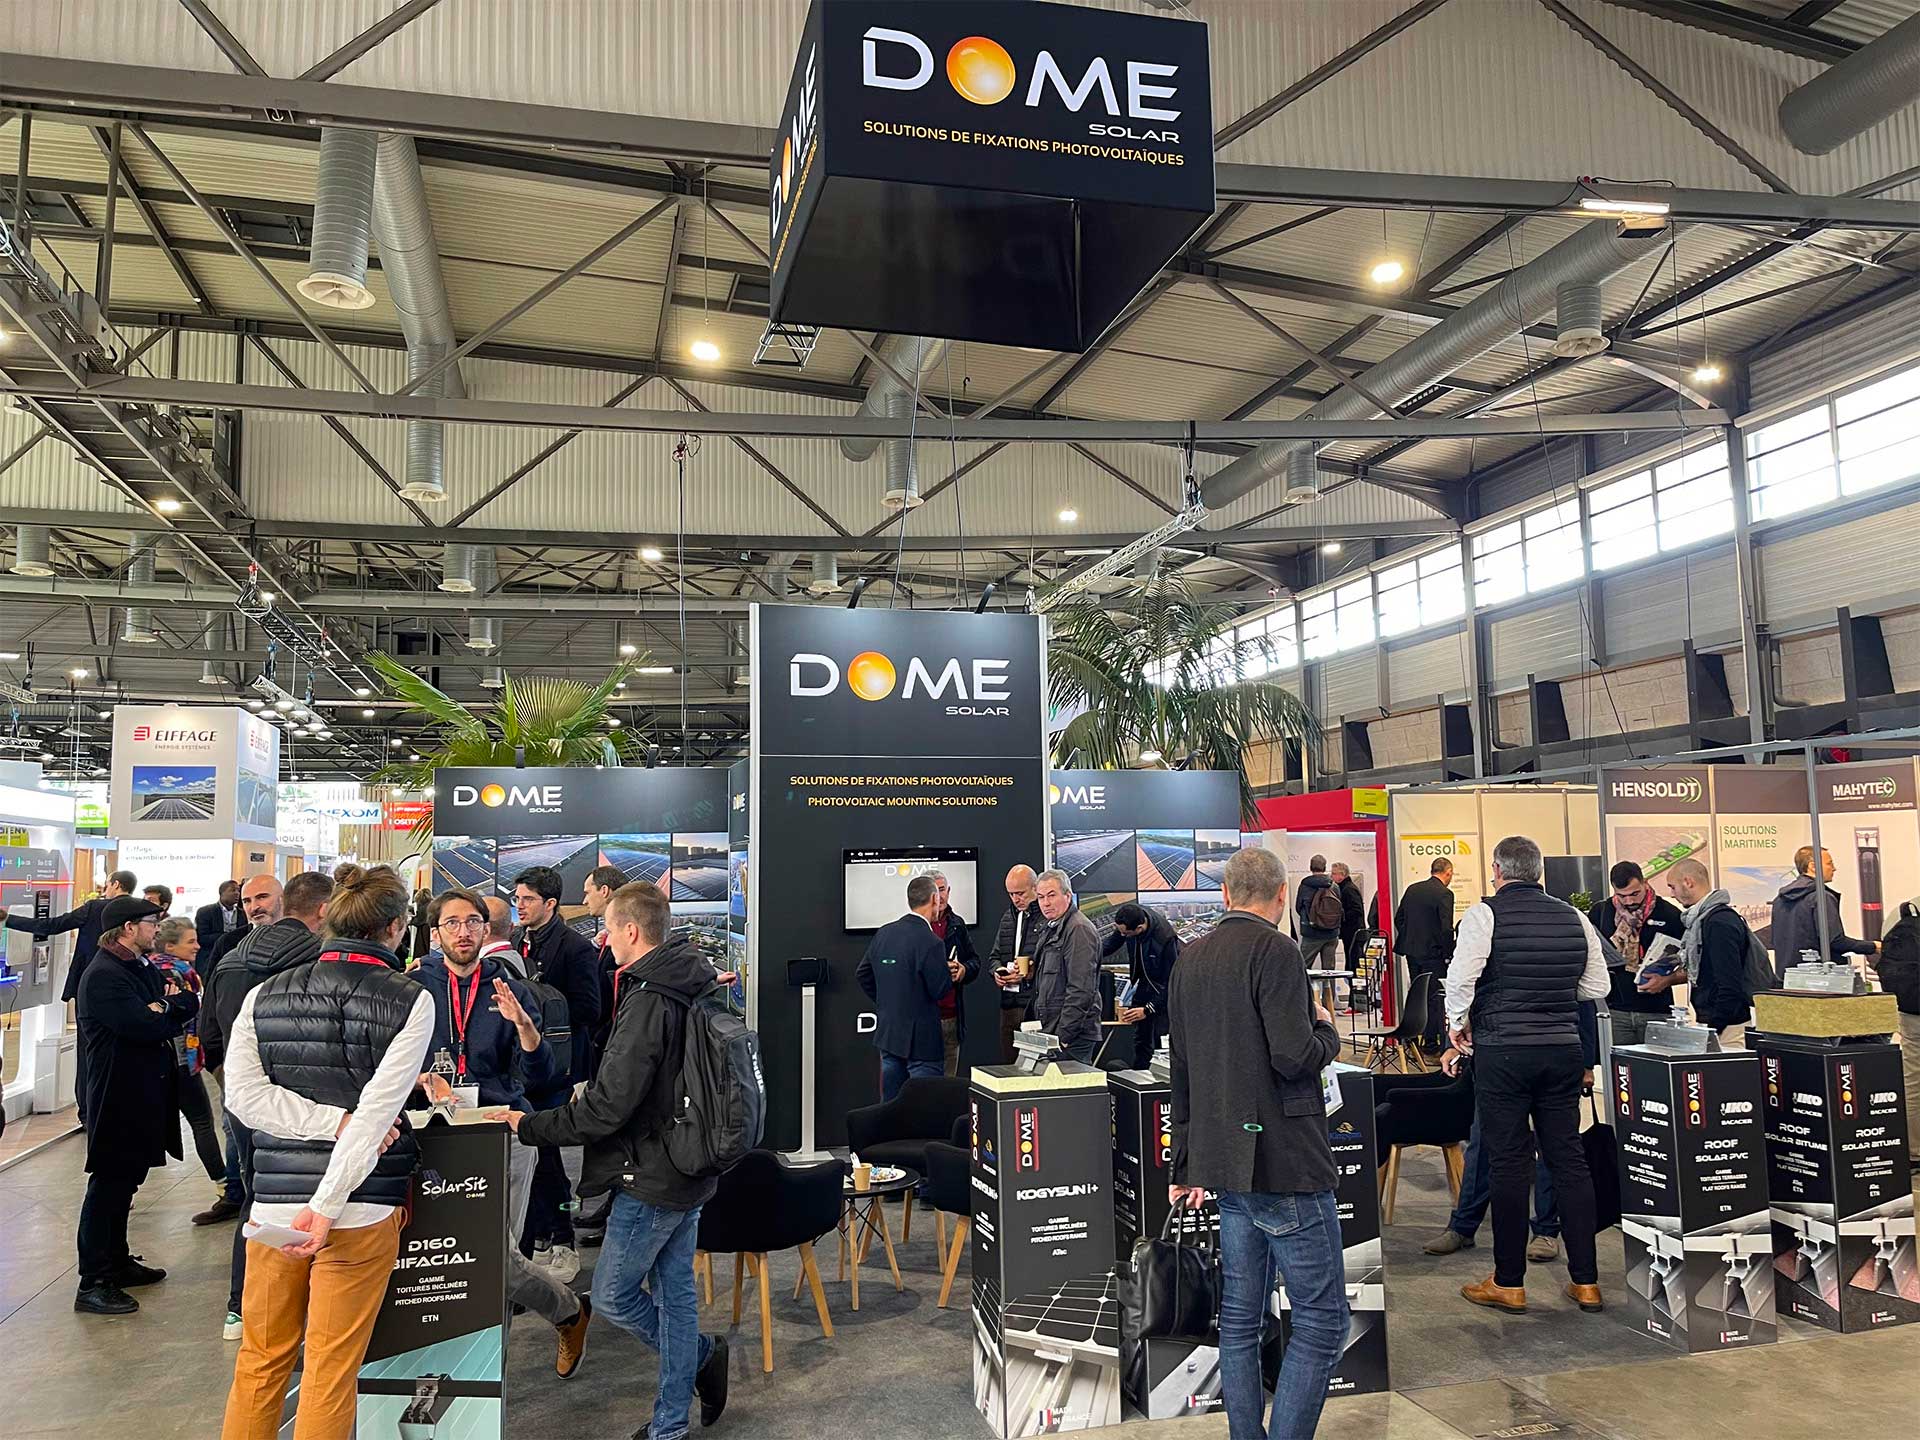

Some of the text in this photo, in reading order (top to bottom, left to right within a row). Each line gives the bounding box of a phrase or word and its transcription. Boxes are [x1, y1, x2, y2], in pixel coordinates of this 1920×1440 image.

[863, 26, 1182, 121] DOME
[1088, 123, 1180, 144] SOLAR
[863, 120, 1184, 166] SOLUTIONS DE FIXATIONS PHOTOVOLTAÏQUES
[790, 651, 1012, 701] DOME
[946, 706, 1010, 716] SOLAR
[155, 730, 218, 742] EIFFAGE
[790, 775, 1013, 787] SOLUTIONS DE FIXATIONS PHOTOVOLTAÏQUES
[453, 784, 563, 807] DOME
[1050, 784, 1106, 805] OME
[1612, 782, 1698, 798] HENSOLDT
[1832, 781, 1893, 797] MAHYTEC
[808, 796, 997, 806] PHOTOVOLTAIC MOUNTING SOLUTIONS
[1723, 825, 1777, 836] SOLUTIONS
[1409, 841, 1456, 856] tecsol
[1724, 838, 1777, 849] MARITIMES
[1767, 1058, 1778, 1107] DOME
[1841, 1064, 1853, 1115] DOME
[1618, 1065, 1630, 1116] DOME
[1688, 1073, 1700, 1124] DOME
[1779, 1122, 1811, 1135] ROOF
[1855, 1126, 1886, 1138] ROOF
[1020, 1113, 1033, 1167] DOME
[1631, 1132, 1659, 1146] ROOF
[1704, 1139, 1739, 1150] ROOF
[1764, 1132, 1828, 1151] SOLAR BITUME
[1841, 1138, 1901, 1152] SOLAR BITUME
[1623, 1144, 1668, 1161] SOLAR PVC
[1695, 1152, 1749, 1163] SOLAR PVC
[422, 1176, 489, 1196] SolarSit
[408, 1237, 457, 1252] D160
[396, 1280, 468, 1294] TOITURES INCLINÉES
[418, 1275, 445, 1284] GAMME
[394, 1292, 468, 1306] PITCHED ROOFS RANGE
[421, 1314, 439, 1323] ETN
